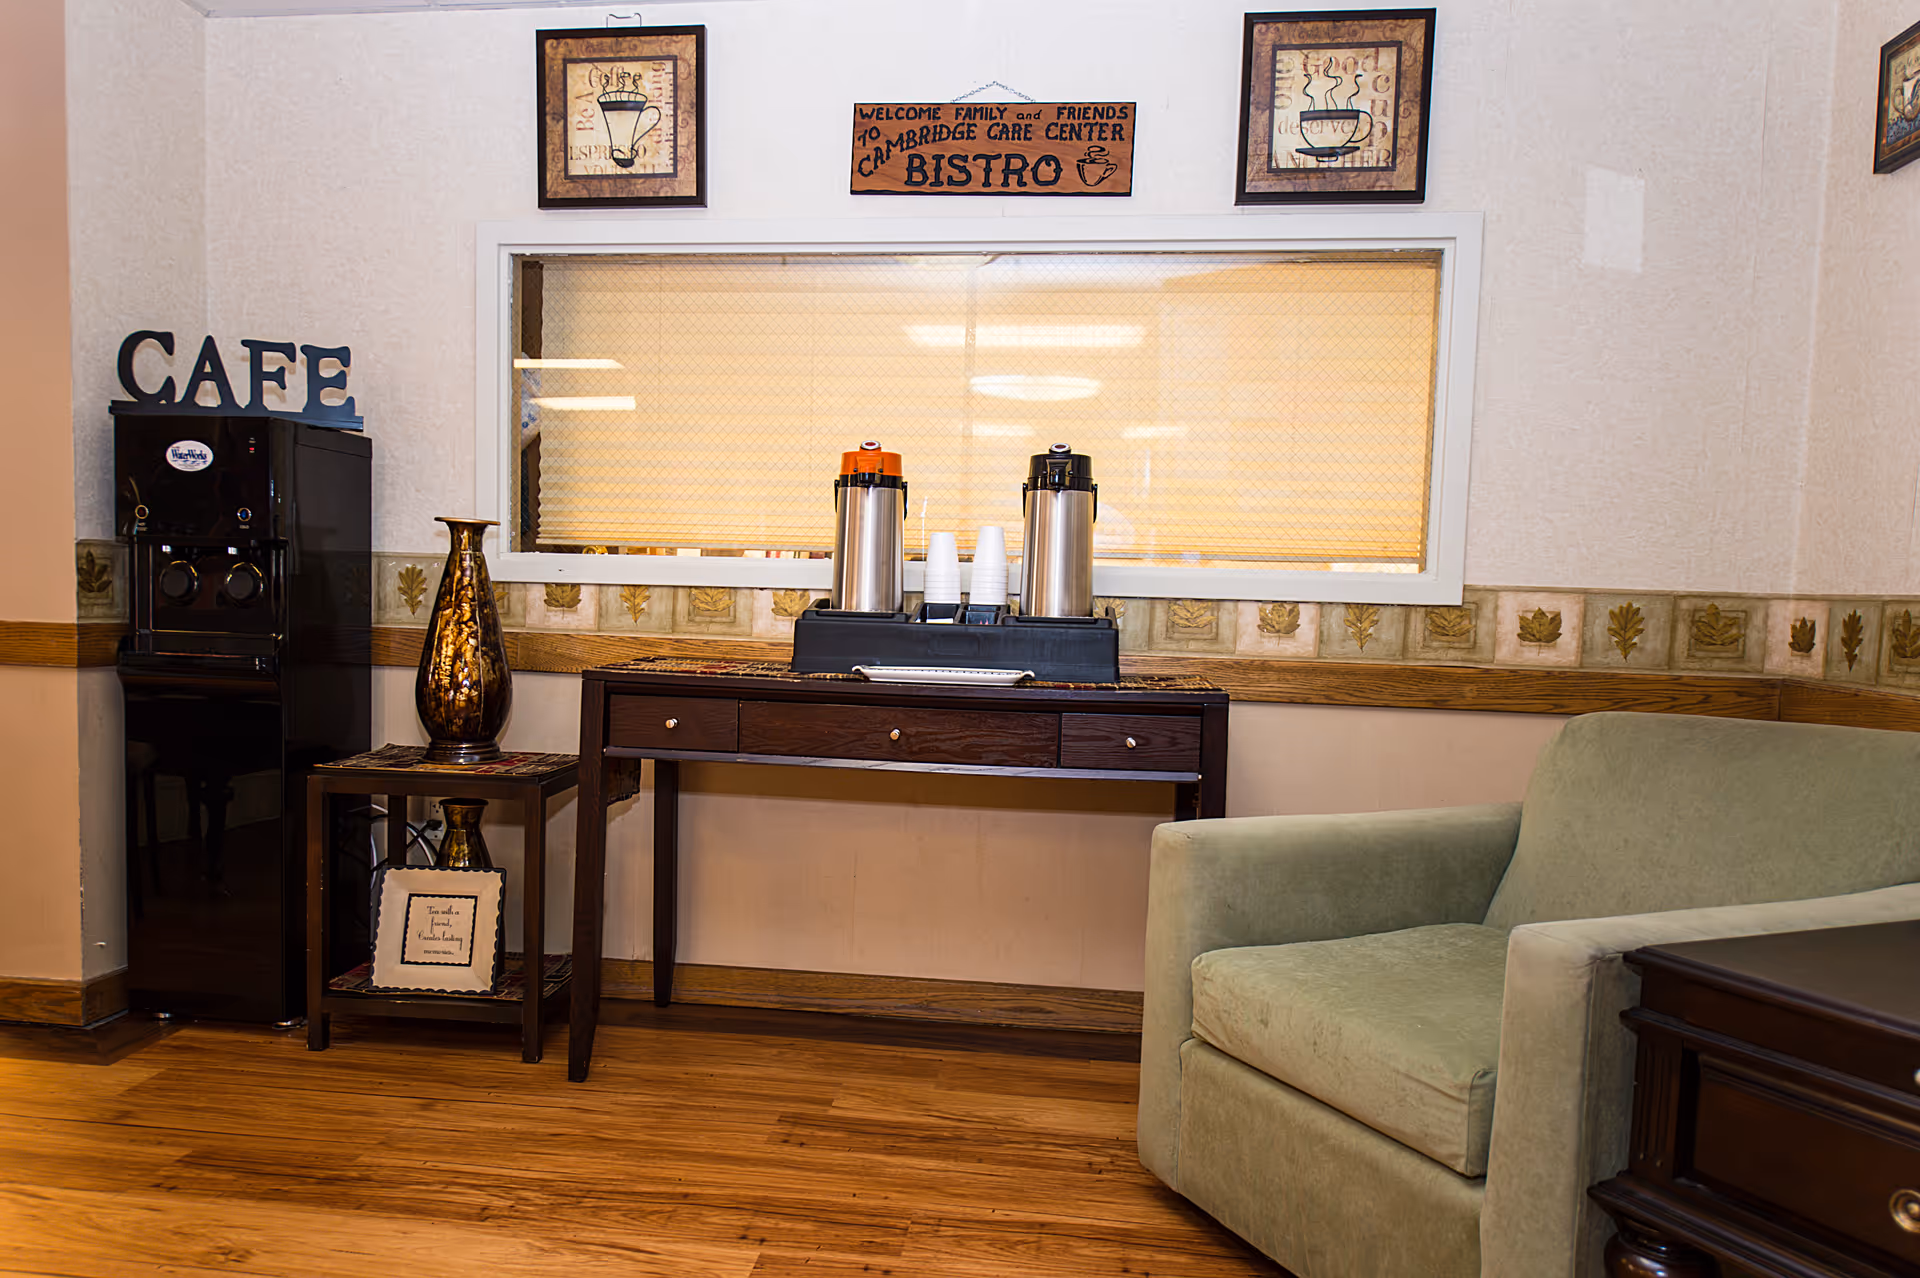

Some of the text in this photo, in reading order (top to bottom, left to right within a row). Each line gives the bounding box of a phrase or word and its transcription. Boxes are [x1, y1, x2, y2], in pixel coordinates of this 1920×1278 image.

[1302, 47, 1381, 76] Good
[859, 106, 1129, 121] WELCOME FAMILY and FRIENDS
[857, 126, 881, 147] TO
[857, 121, 1125, 178] CAMBRIDGE CARE CENTER
[904, 153, 1063, 188] BISTRO
[117, 330, 356, 416] CAFE
[426, 905, 439, 915] Tea
[441, 905, 454, 915] with
[430, 916, 452, 934] friend,
[442, 931, 463, 951] lasting
